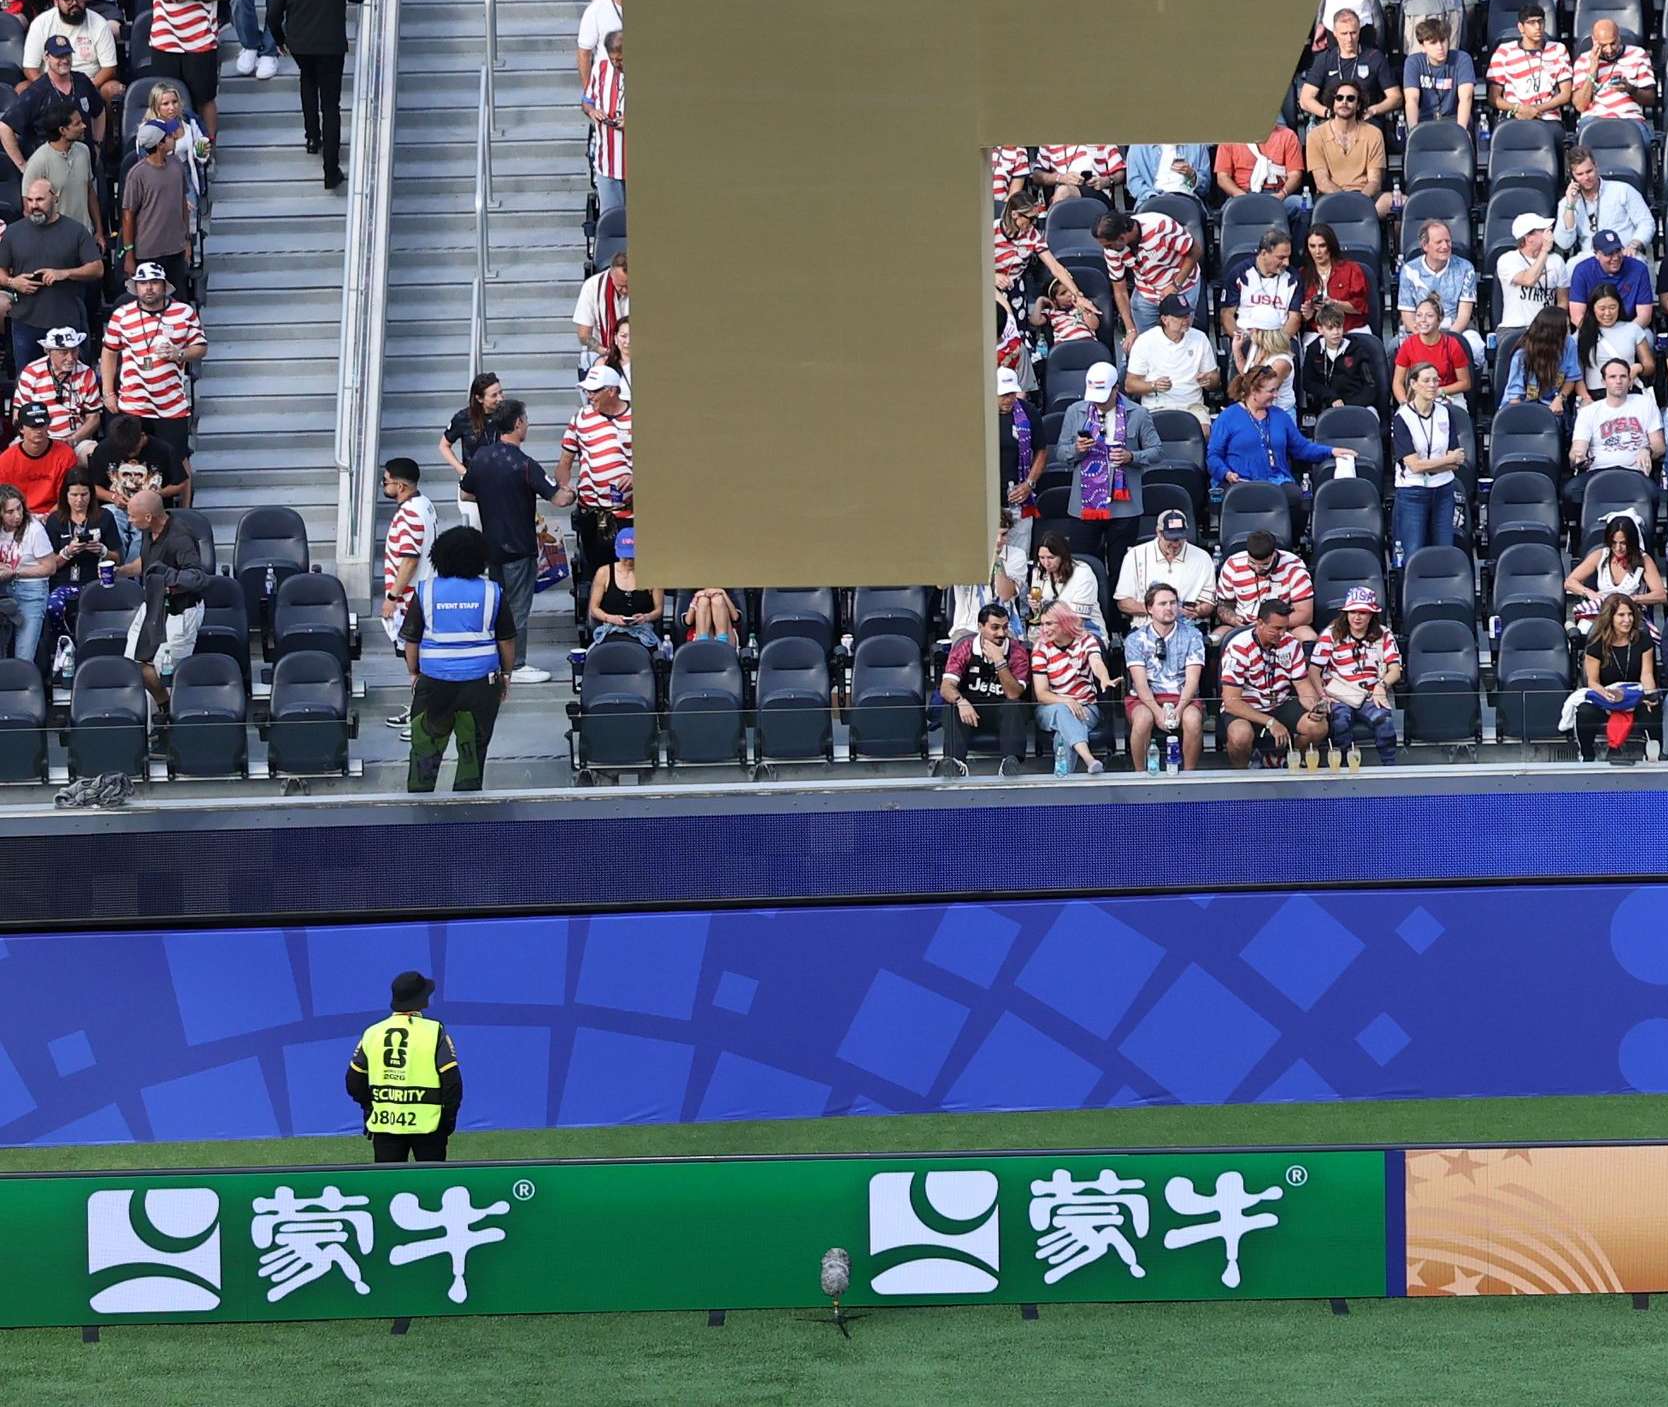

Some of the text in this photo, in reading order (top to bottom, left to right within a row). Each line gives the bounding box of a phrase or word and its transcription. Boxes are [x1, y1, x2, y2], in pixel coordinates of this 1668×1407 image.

[1250, 295, 1284, 307] USA
[1600, 417, 1640, 440] USA
[1349, 590, 1375, 603] USA
[436, 601, 481, 611] EVENT STAFF
[967, 677, 1005, 697] Jeep
[383, 1073, 406, 1081] 2026
